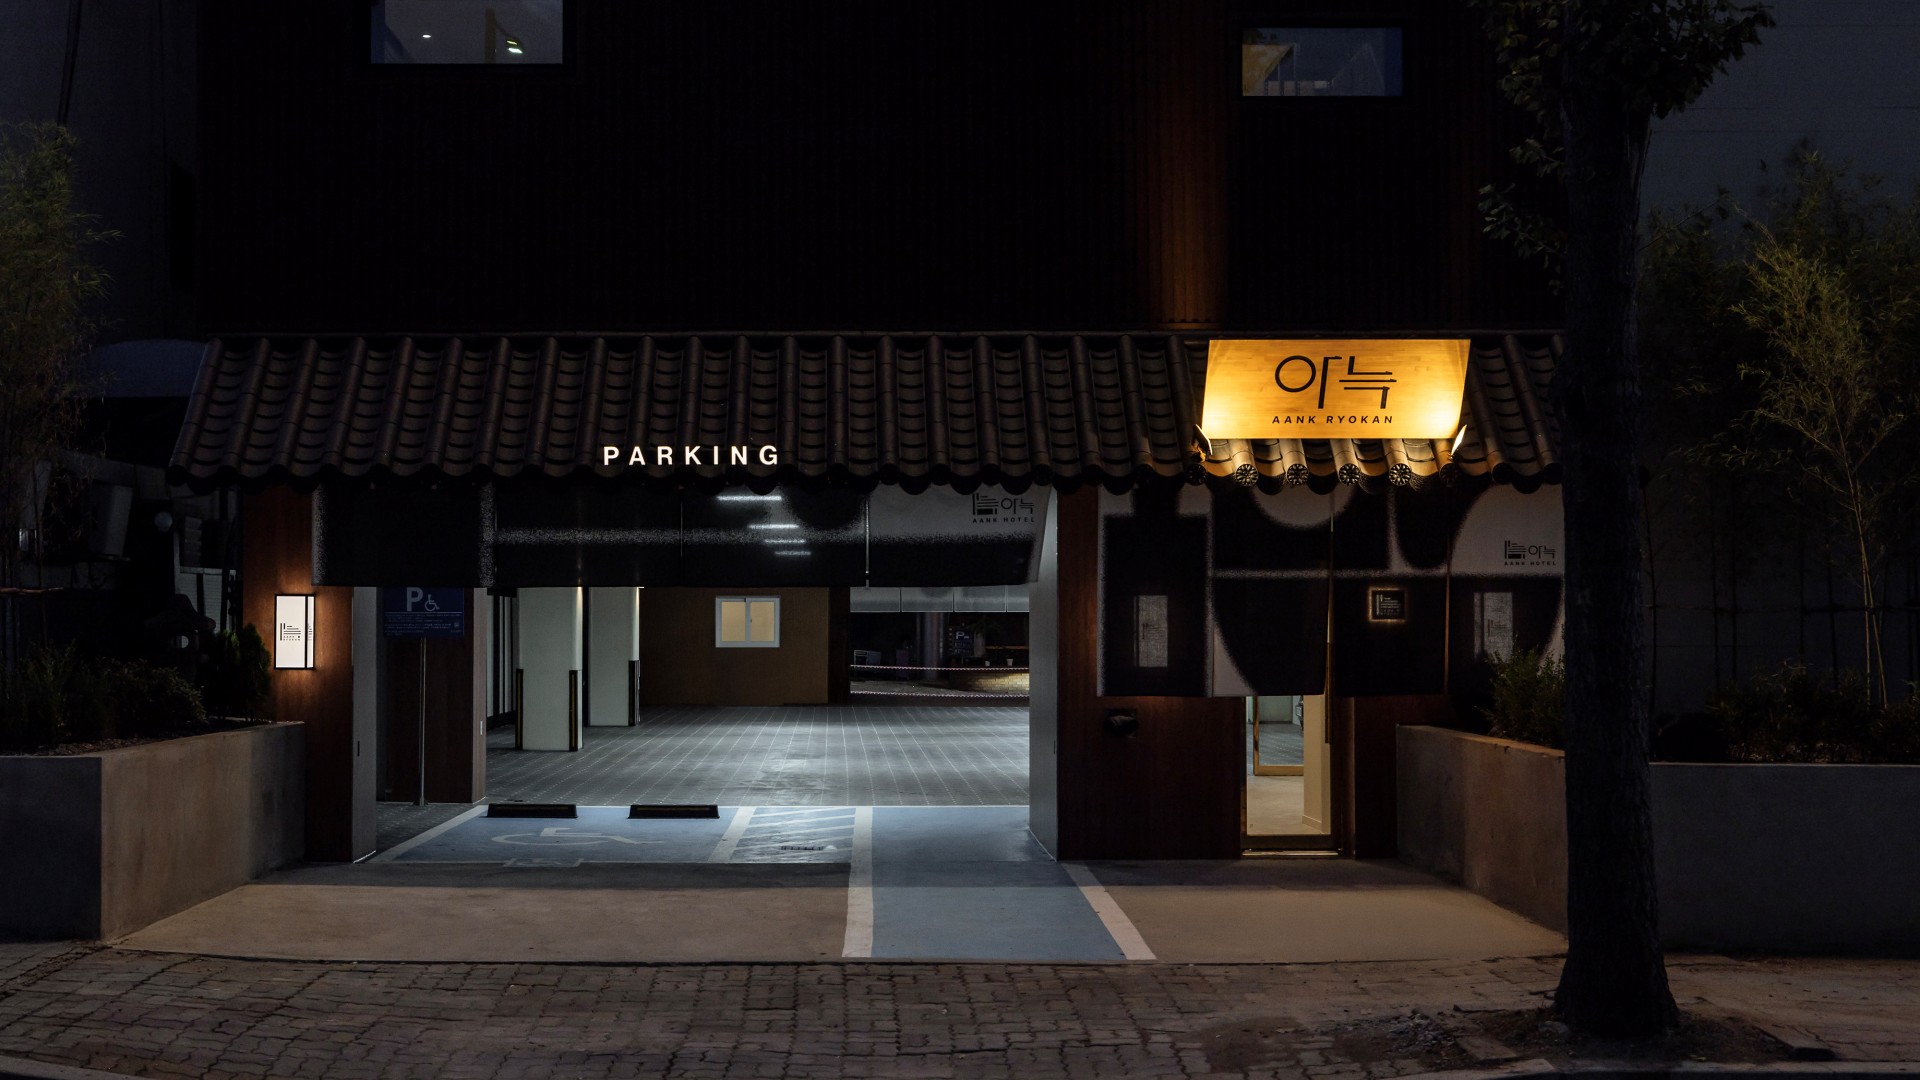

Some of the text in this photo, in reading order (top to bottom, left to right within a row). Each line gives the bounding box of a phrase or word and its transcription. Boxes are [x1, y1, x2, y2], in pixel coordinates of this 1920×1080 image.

[1274, 355, 1397, 409] 아늑
[1271, 415, 1393, 424] AANK RYOKAN
[603, 445, 778, 466] PARKING
[406, 587, 423, 612] P
